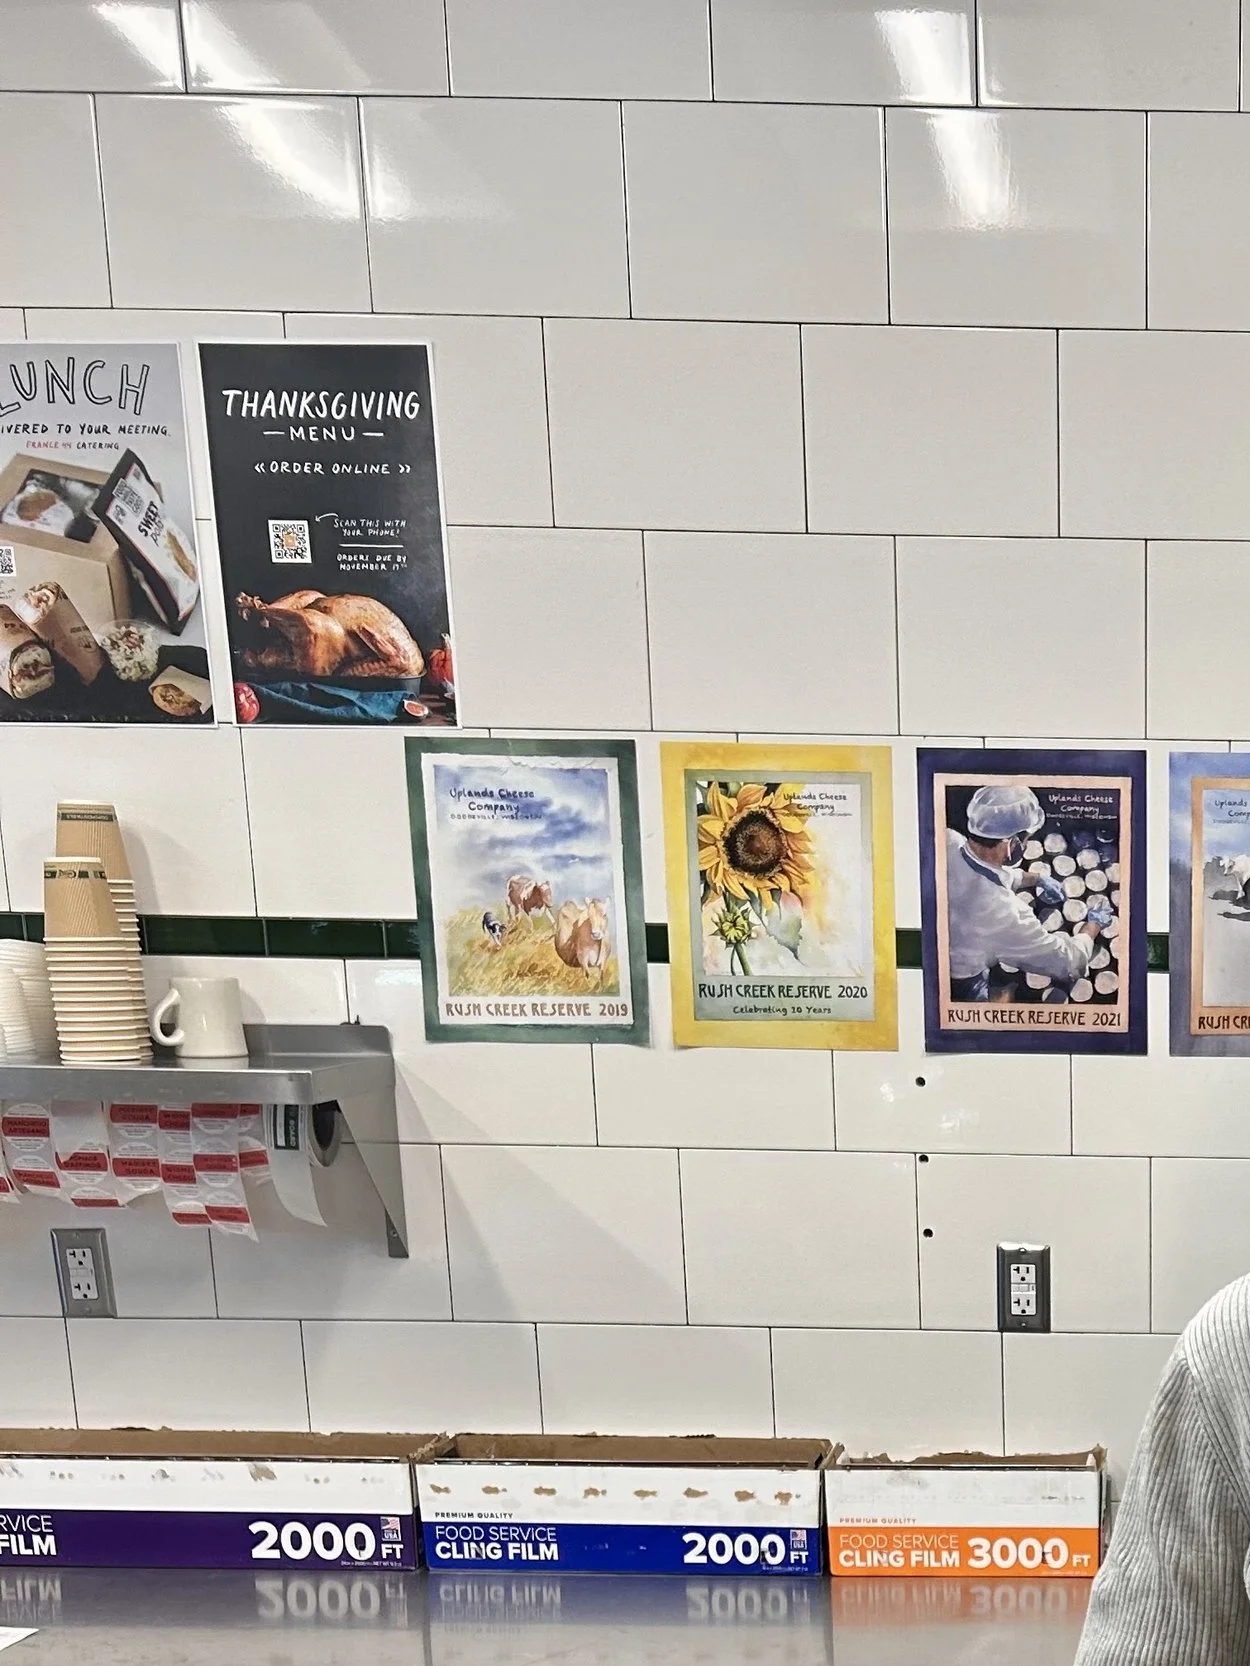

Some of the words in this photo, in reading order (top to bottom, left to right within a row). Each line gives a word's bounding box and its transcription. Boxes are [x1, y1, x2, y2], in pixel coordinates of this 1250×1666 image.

[222, 389, 420, 420] THANKSGIVING
[57, 424, 71, 435] TO
[80, 423, 111, 436] YOUR
[289, 426, 355, 441] MENU
[76, 441, 119, 450] CATERING
[269, 461, 324, 475] ORDER
[332, 461, 390, 475] ONLINE
[334, 518, 356, 528] SCAN
[360, 519, 379, 527] THIS
[384, 520, 407, 528] WITH
[342, 528, 363, 537] YOUR
[337, 553, 369, 562] ORDERS
[376, 554, 392, 562] DUE
[397, 554, 406, 563] BY
[340, 563, 387, 571] NOVEMBER
[449, 788, 494, 801] Uplands
[498, 788, 534, 798] Cheese
[783, 792, 816, 804] Uplands
[819, 793, 847, 801] Cheese
[1048, 793, 1082, 804] Uplands
[1085, 794, 1113, 803] Cheese
[468, 801, 520, 815] Company
[797, 804, 835, 814] Company
[1060, 804, 1099, 814] Company
[1214, 799, 1246, 809] Uplands
[698, 984, 733, 999] RUSH
[736, 984, 775, 999] CREEK
[778, 984, 832, 999] RESERVE
[838, 984, 868, 999] 2020
[445, 1001, 482, 1017] RUSH
[486, 1001, 528, 1017] CREEK
[531, 1001, 591, 1017] RESERVE
[599, 1002, 629, 1018] 2019
[733, 1005, 787, 1017] Celebrating
[805, 1005, 832, 1015] Years
[948, 1009, 981, 1024] RUSH
[984, 1009, 1024, 1025] CREEK
[1028, 1010, 1085, 1026] RESERVE
[1092, 1011, 1121, 1026] 2021
[1198, 1015, 1230, 1031] RUSH
[436, 1526, 484, 1541] FOOD
[488, 1526, 557, 1541] SERVICE
[248, 1521, 376, 1561] 2000
[682, 1531, 787, 1565] 2000
[839, 1534, 888, 1550] FOOD
[892, 1534, 959, 1550] SERVICE
[381, 1544, 404, 1559] FT
[435, 1542, 502, 1560] CLING
[508, 1542, 559, 1561] FILM
[790, 1551, 808, 1564] FT
[968, 1537, 1069, 1569] 3000
[1072, 1554, 1090, 1568] FT
[838, 1550, 905, 1568] CLING
[911, 1550, 960, 1568] FILM
